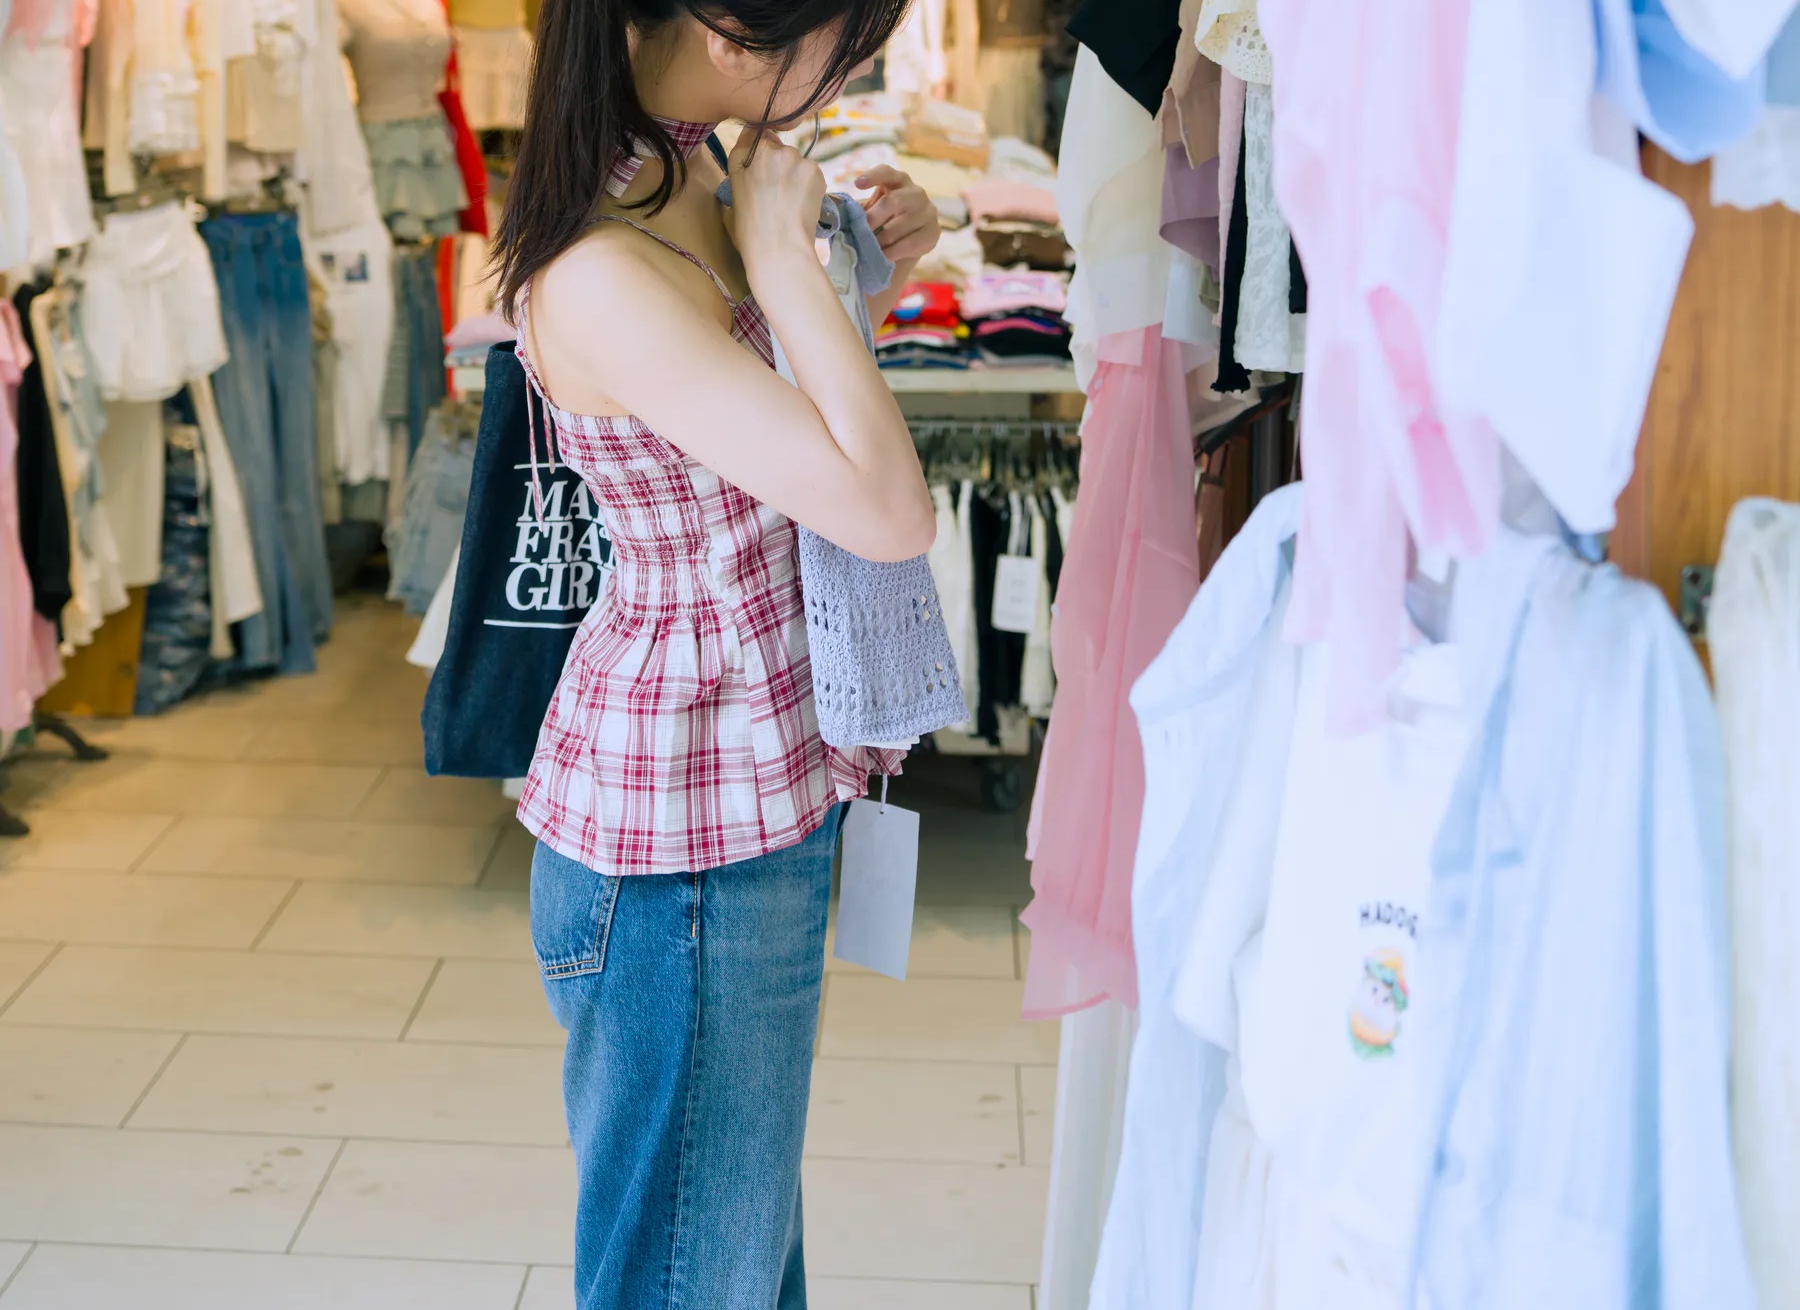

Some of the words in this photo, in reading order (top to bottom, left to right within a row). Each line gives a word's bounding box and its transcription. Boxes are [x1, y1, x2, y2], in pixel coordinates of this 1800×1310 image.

[518, 480, 601, 523] MA
[510, 522, 617, 570] FRA
[505, 562, 602, 611] GIR
